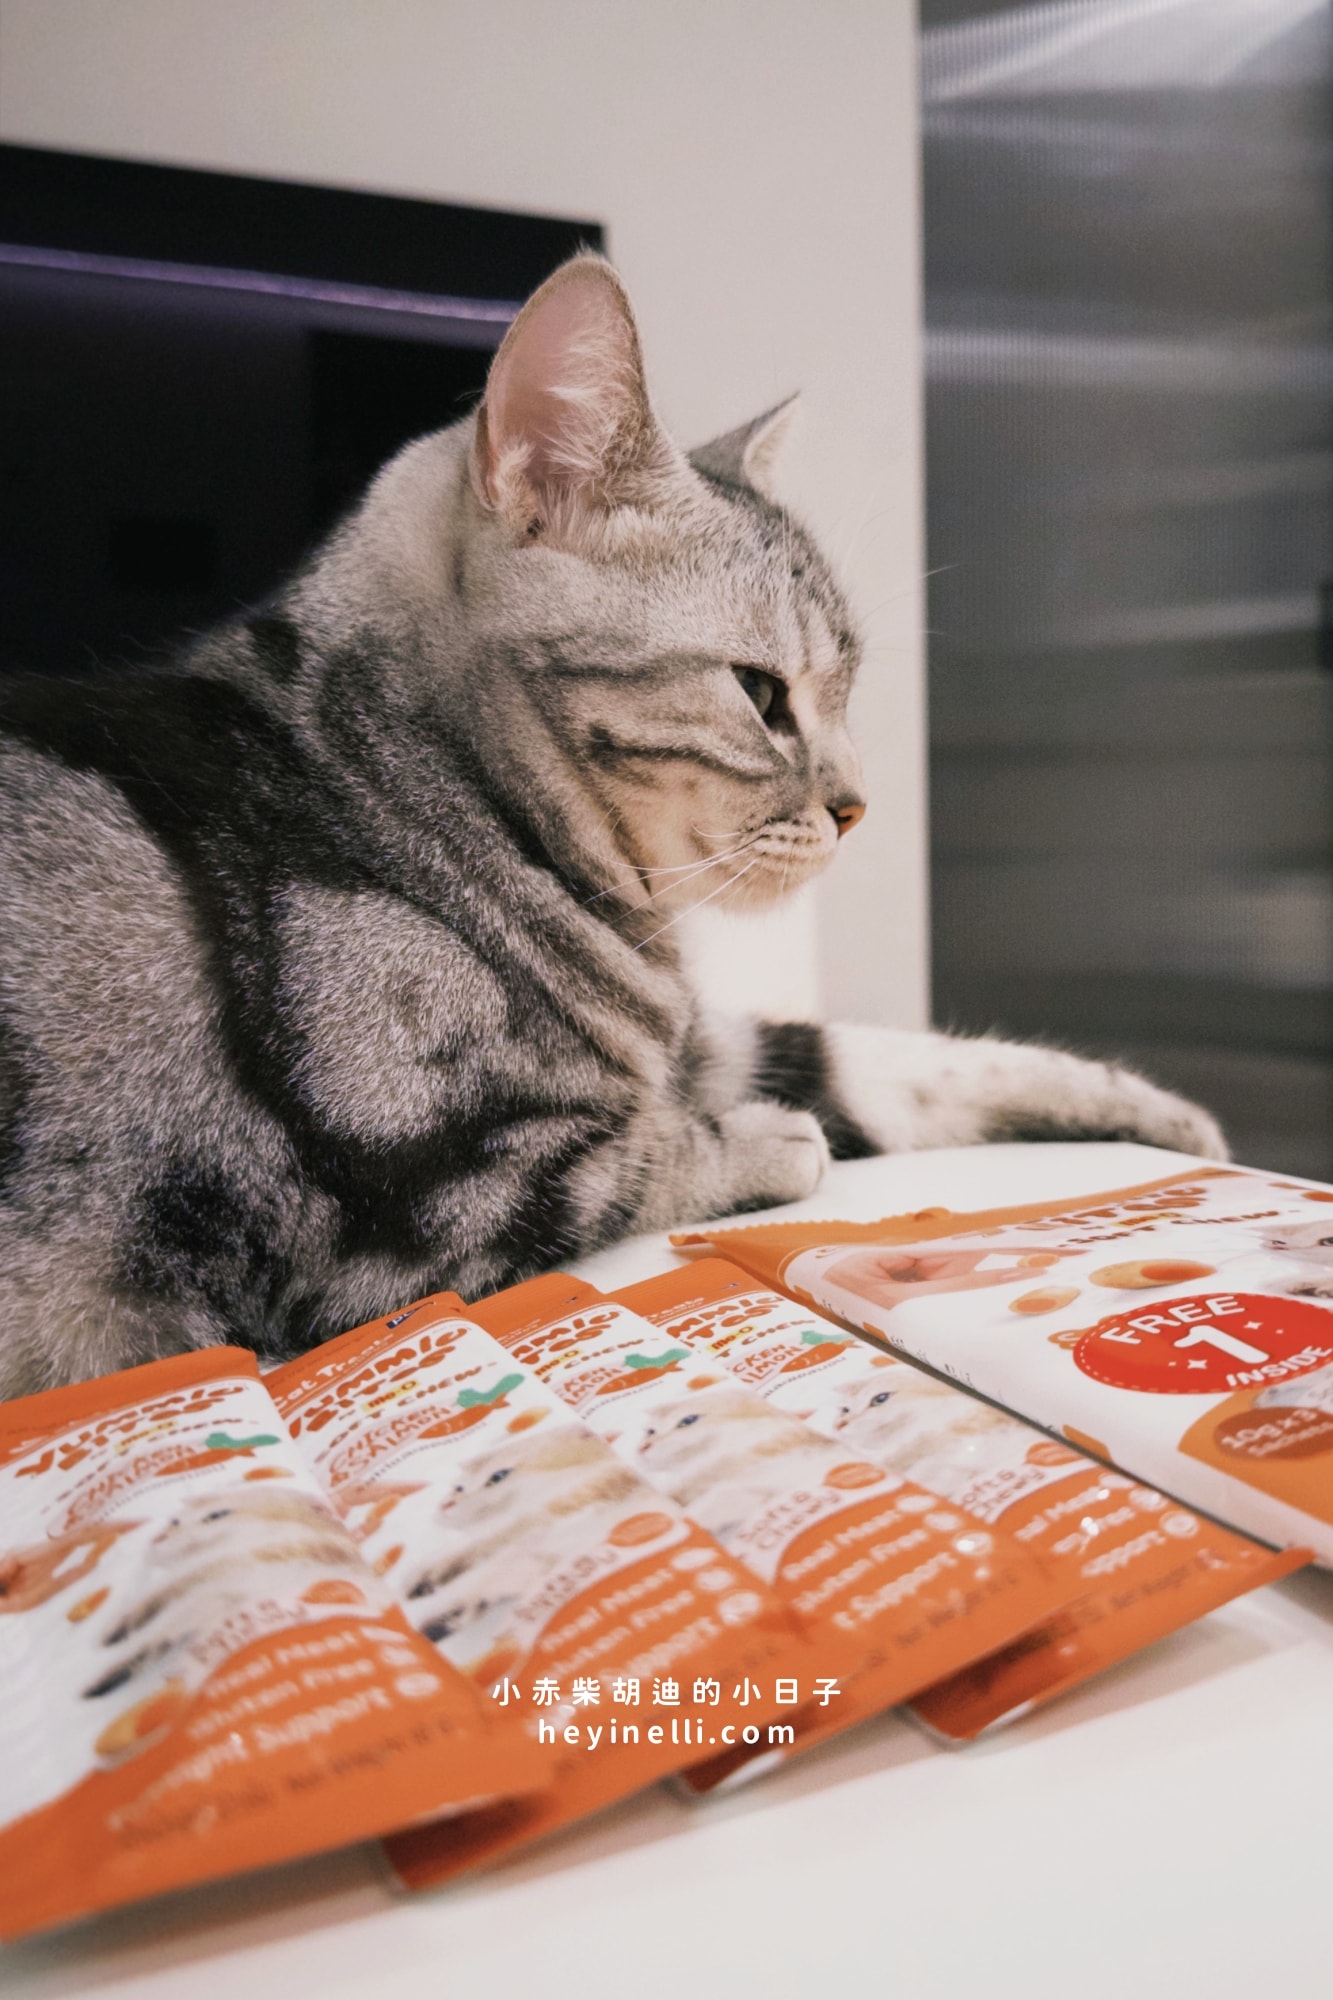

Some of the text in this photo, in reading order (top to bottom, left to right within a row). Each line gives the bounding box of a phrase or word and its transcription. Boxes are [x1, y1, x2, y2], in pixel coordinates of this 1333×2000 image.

[1100, 1295, 1245, 1345] FREE
[1173, 1325, 1270, 1364] 1
[1225, 1345, 1333, 1387] INSIDE
